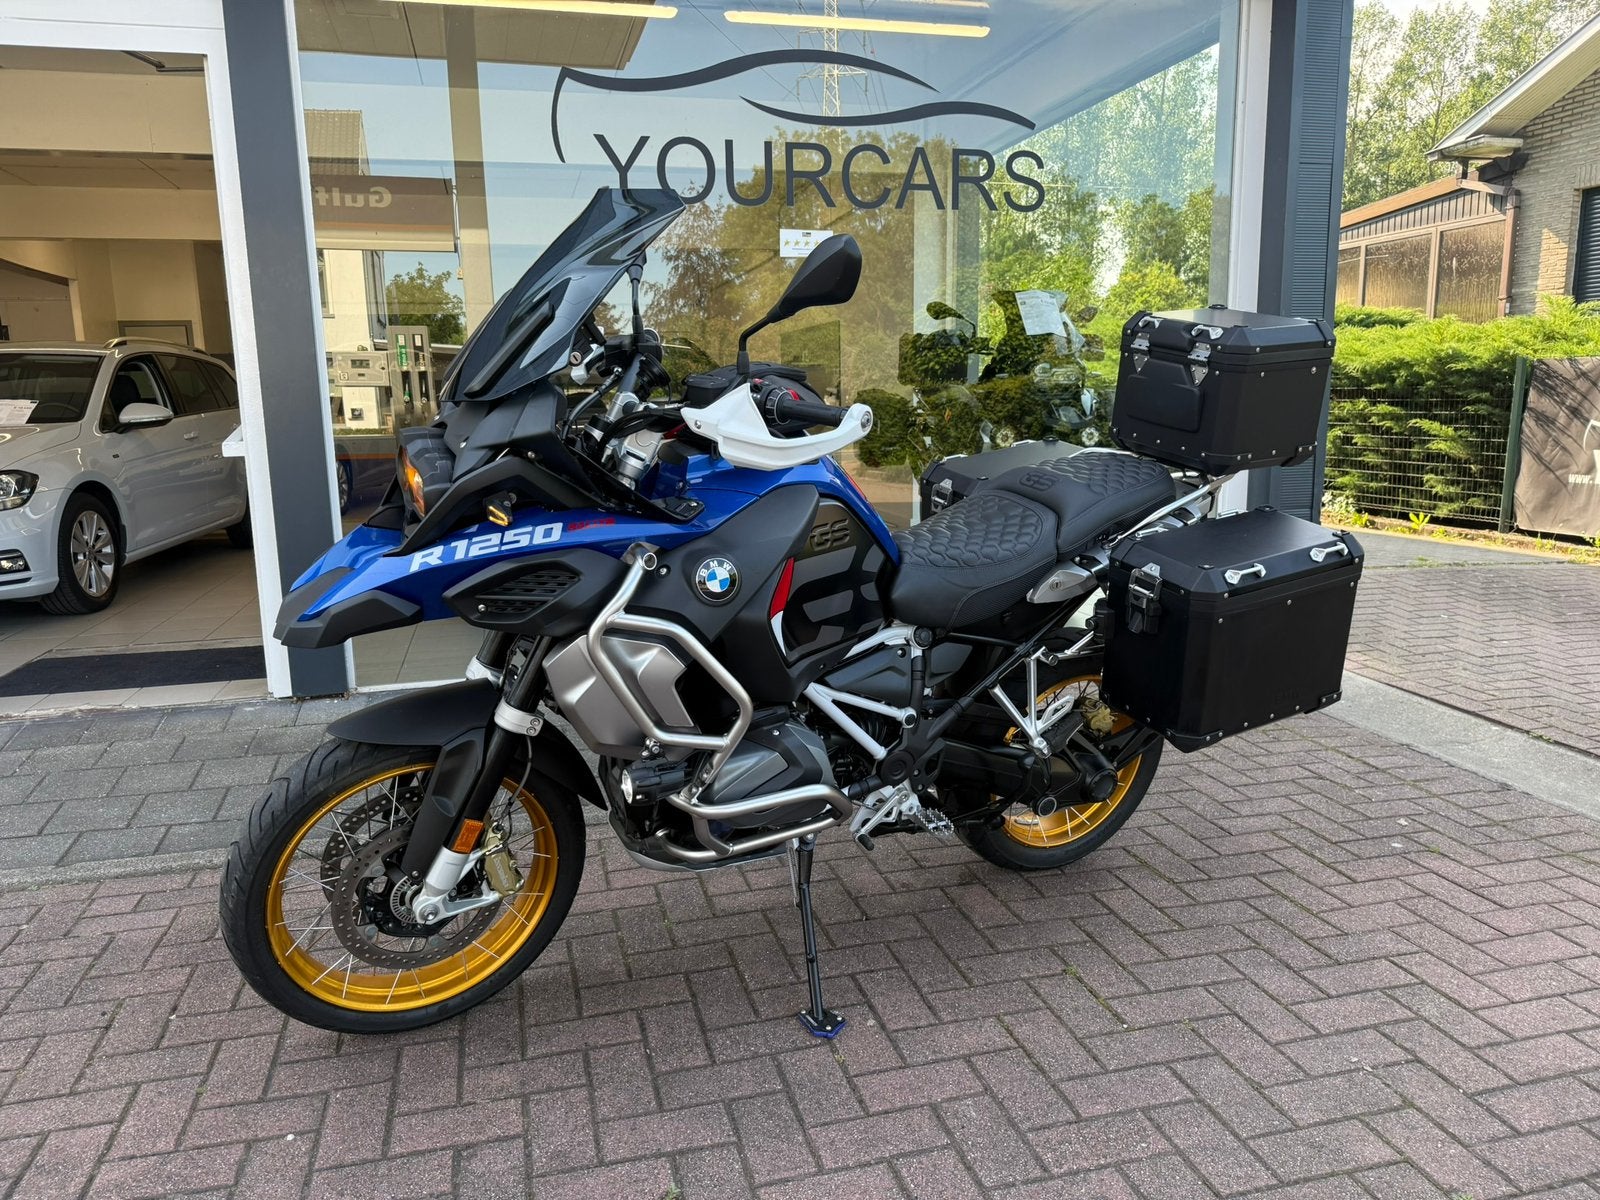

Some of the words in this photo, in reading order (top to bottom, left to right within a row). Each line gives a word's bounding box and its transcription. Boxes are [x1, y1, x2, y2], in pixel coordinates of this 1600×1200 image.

[594, 133, 1045, 213] YOURCARS
[409, 545, 445, 573] R
[450, 522, 564, 561] 1250
[809, 518, 851, 551] GS
